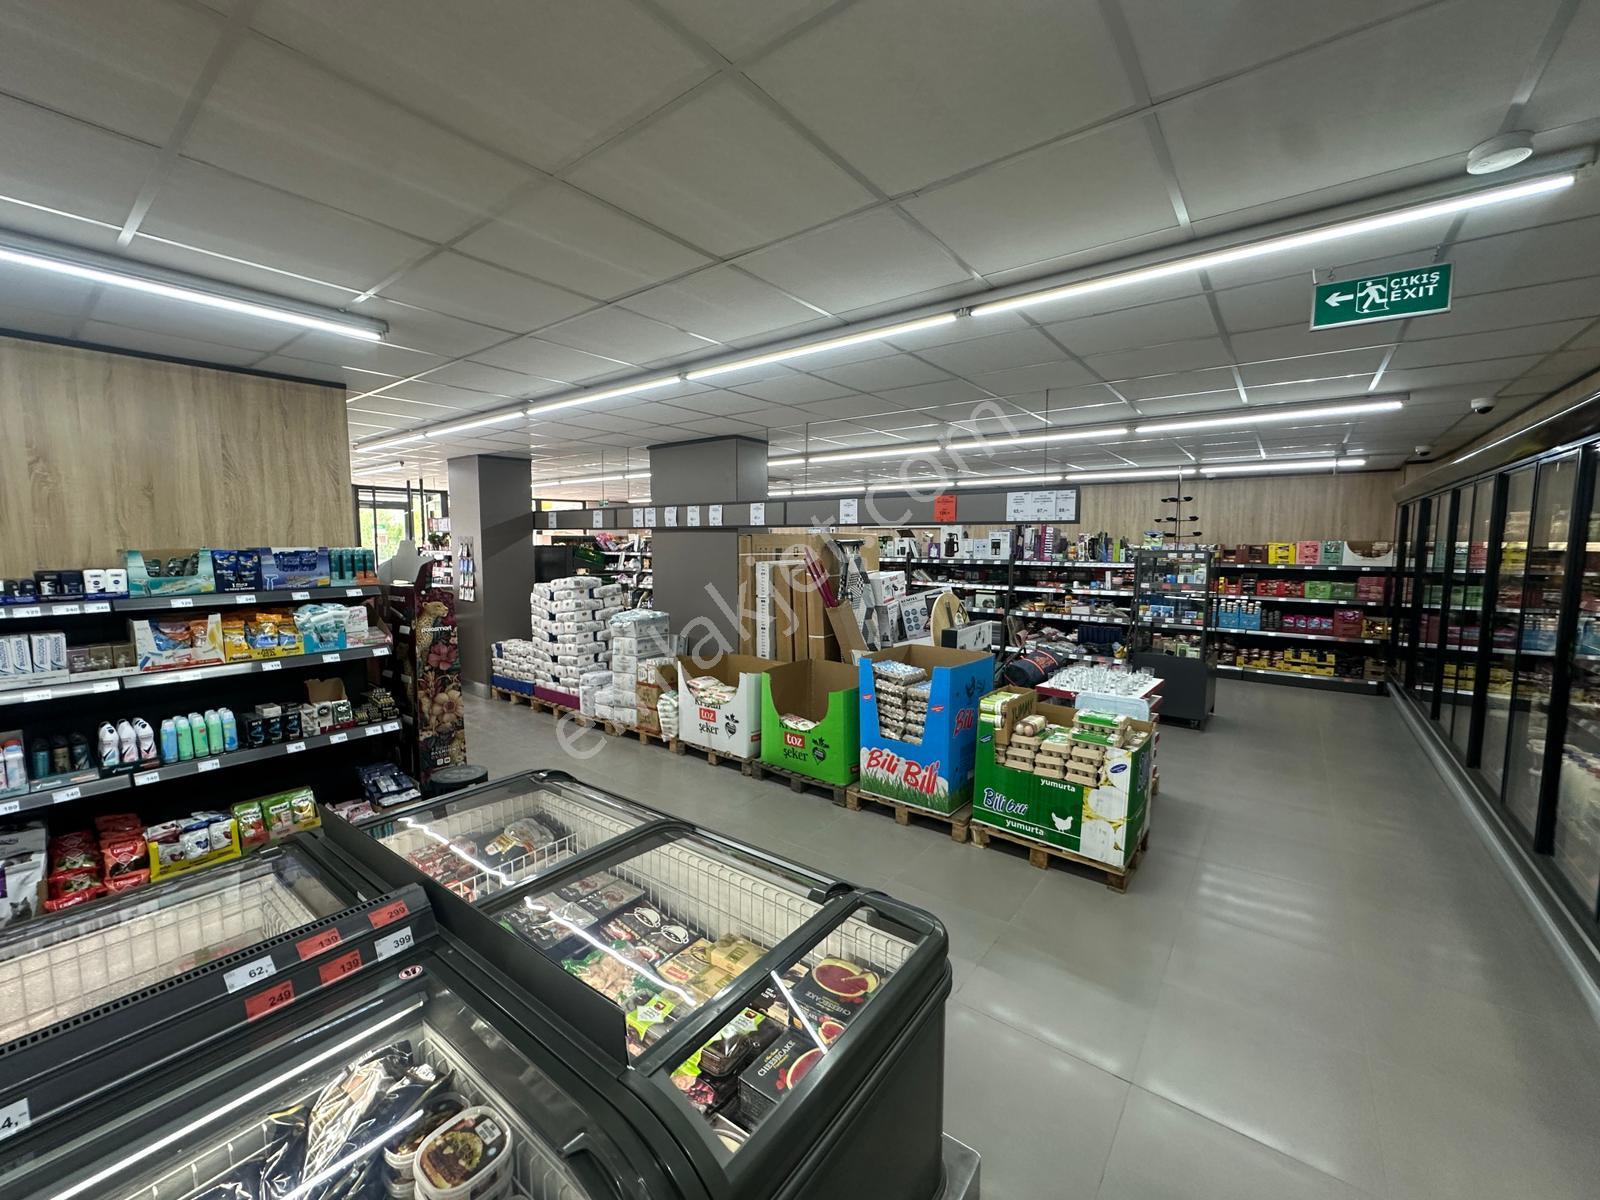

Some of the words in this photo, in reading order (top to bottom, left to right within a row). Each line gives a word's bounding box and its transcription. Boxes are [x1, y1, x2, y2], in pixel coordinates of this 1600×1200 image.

[1390, 271, 1441, 289] ÇIKIŞ
[1390, 284, 1438, 301] EXIT
[701, 709, 714, 720] toz
[699, 722, 719, 736] şeker
[786, 734, 804, 748] toz
[783, 747, 809, 762] şeker
[866, 749, 900, 775] Bili
[903, 760, 940, 795] Bili
[1040, 778, 1076, 793] yumurta
[983, 787, 1006, 813] Bili
[1005, 819, 1045, 836] yumurta
[387, 906, 406, 919] 299
[319, 935, 338, 949] 139
[393, 934, 411, 949] 399
[339, 958, 359, 974] 139
[268, 990, 291, 1008] 249
[806, 991, 852, 1016] CHEESECAKE
[757, 1039, 796, 1077] CHEESECAKE
